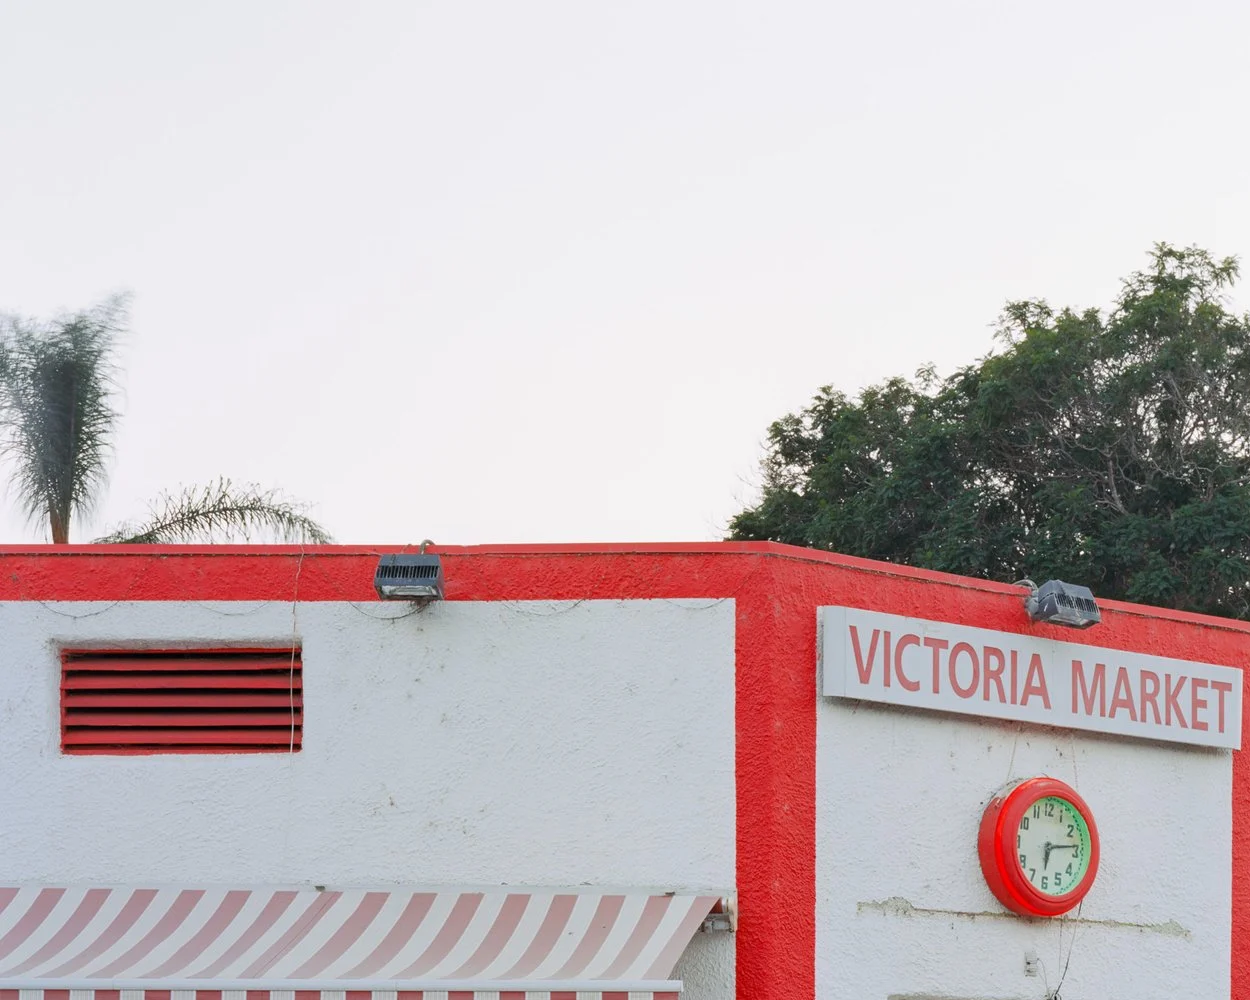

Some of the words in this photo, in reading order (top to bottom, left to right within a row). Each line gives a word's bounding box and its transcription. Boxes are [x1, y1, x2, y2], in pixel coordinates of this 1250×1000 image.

[849, 625, 1052, 711] VICTORIA
[1071, 659, 1234, 734] MARKET
[1044, 803, 1055, 817] 12
[1067, 824, 1074, 838] 2
[1065, 862, 1073, 877] 4
[1041, 876, 1048, 890] 6
[1054, 872, 1062, 886] 5
